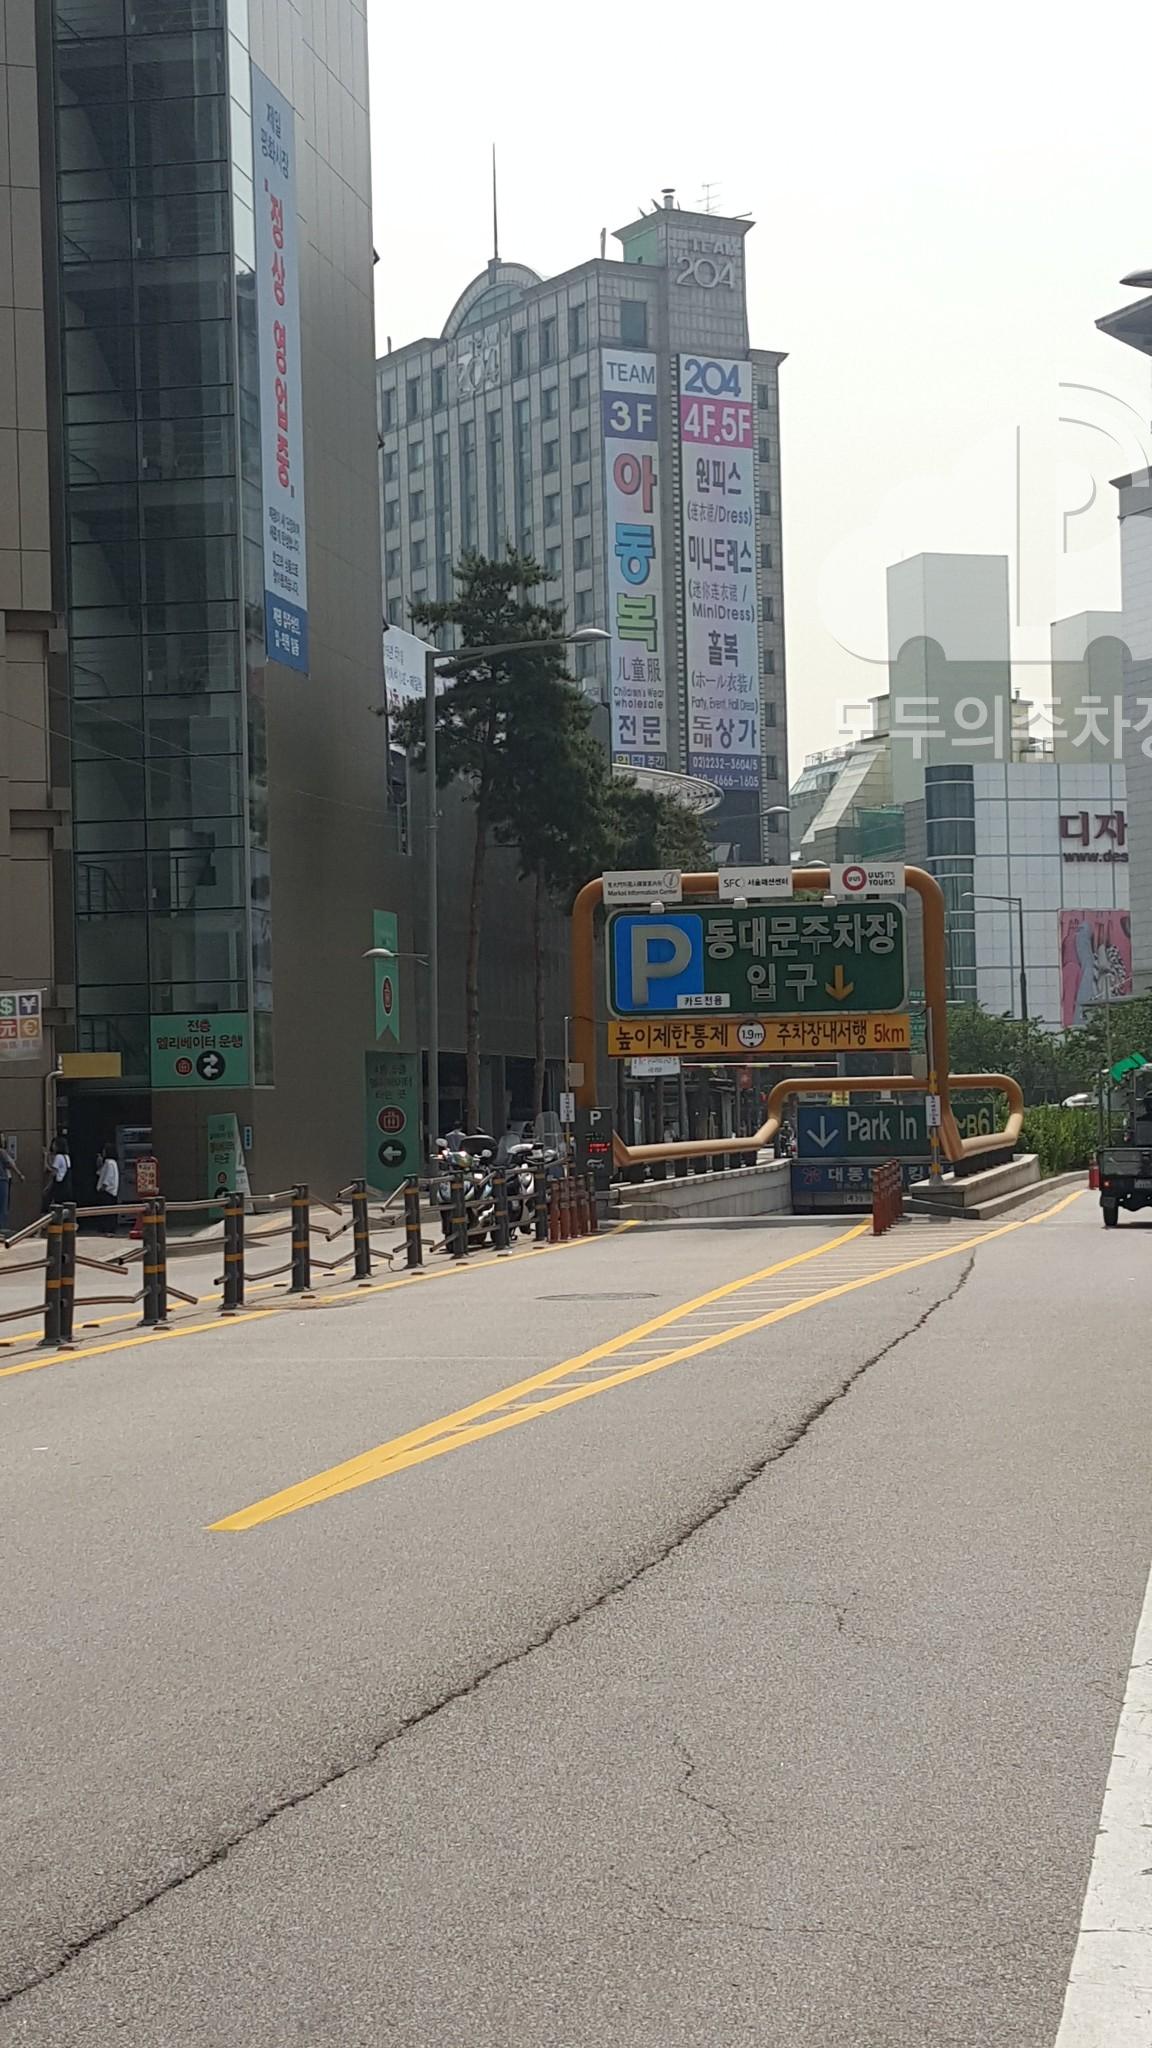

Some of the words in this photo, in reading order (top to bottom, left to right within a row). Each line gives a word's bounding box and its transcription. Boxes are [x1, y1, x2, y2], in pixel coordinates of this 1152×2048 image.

[267, 103, 280, 139] 제일
[261, 127, 289, 179] 평화시장
[692, 237, 736, 257] TEAM
[676, 256, 737, 289] 204
[606, 361, 656, 385] TEAM
[684, 358, 742, 397] 204
[609, 400, 653, 433] 3F
[684, 402, 752, 443] 4F.5F
[696, 457, 743, 495] 원피스
[613, 453, 658, 653] 아동복
[688, 535, 753, 574] 미니드레스
[708, 629, 740, 668] 홀복
[614, 698, 664, 710] wholesale
[618, 715, 661, 745] 전문
[1059, 810, 1128, 847] 디자
[723, 878, 741, 888] SFC
[748, 877, 789, 887] 서울패션센터
[705, 912, 898, 960] 동대문주차장
[631, 924, 692, 1006] P
[746, 963, 818, 1003] 입구
[684, 995, 723, 1007] 카드전용
[0, 1020, 16, 1037] 元
[156, 1035, 216, 1050] 엘리베이터
[616, 1023, 729, 1051] 높이제한통제
[777, 1019, 867, 1048] 주차장내서행
[873, 1022, 905, 1044] 5km
[589, 1110, 602, 1126] P
[847, 1110, 891, 1141] Park
[900, 1109, 918, 1140] In
